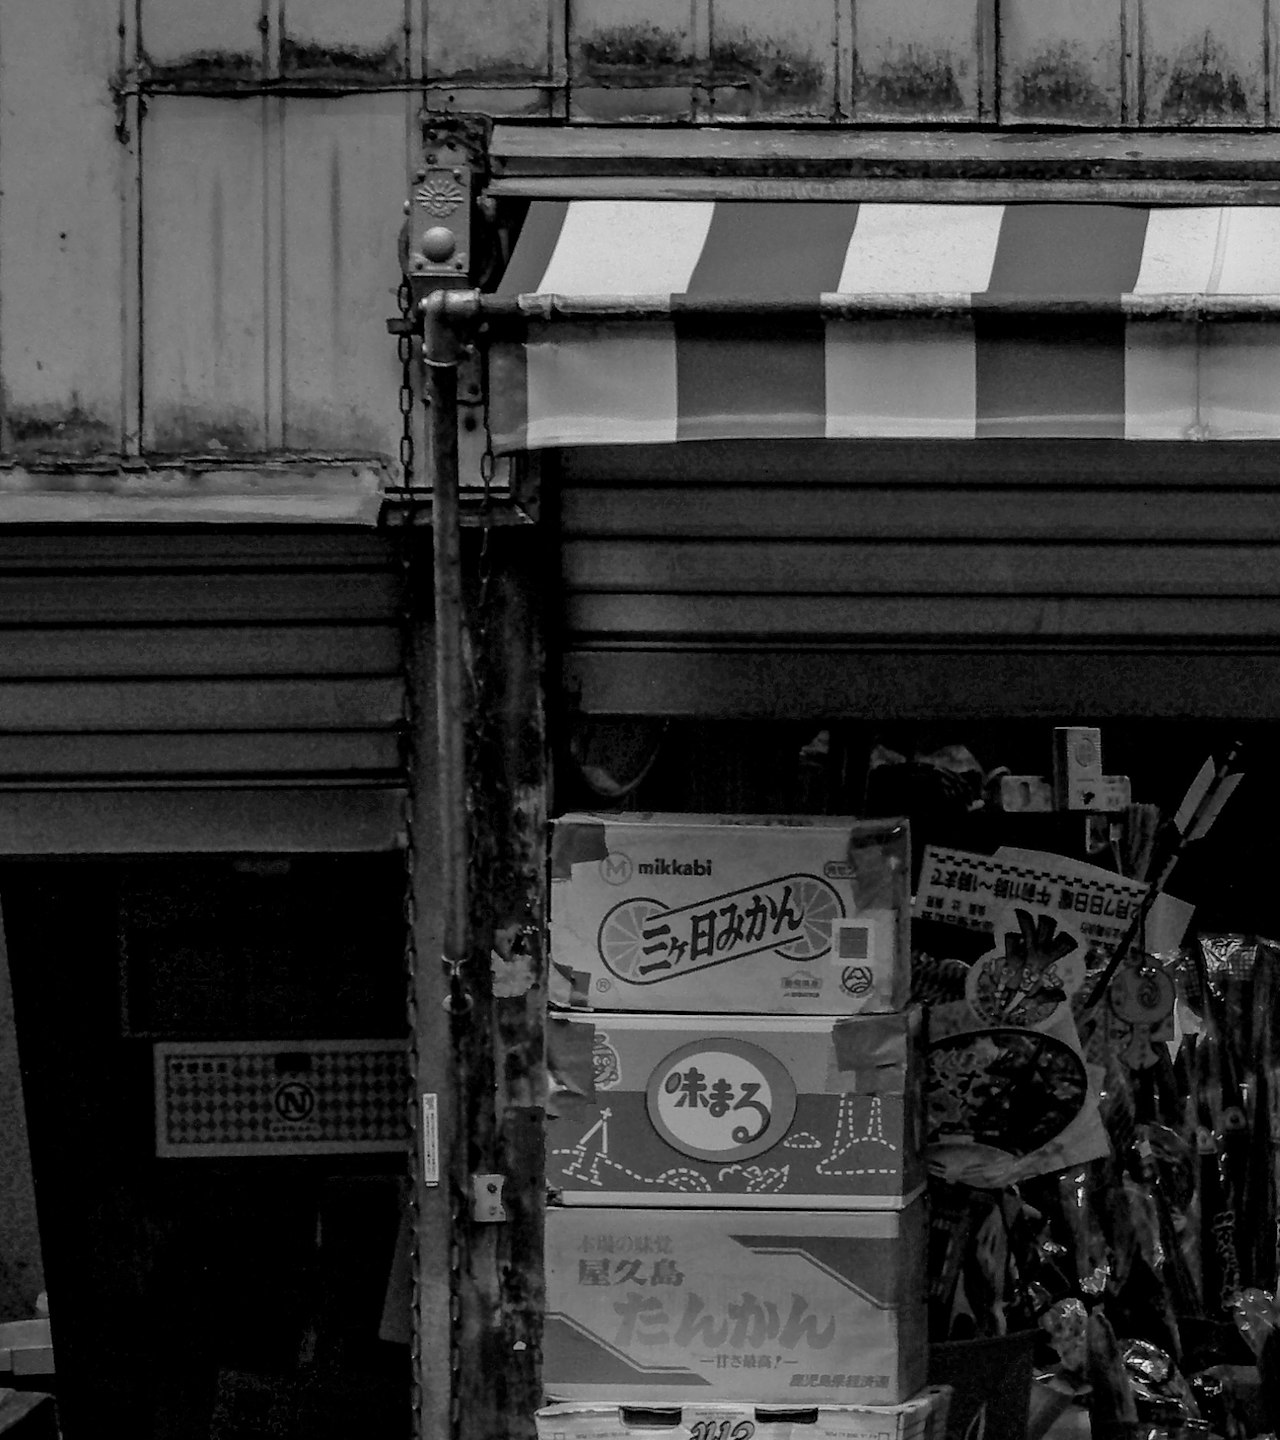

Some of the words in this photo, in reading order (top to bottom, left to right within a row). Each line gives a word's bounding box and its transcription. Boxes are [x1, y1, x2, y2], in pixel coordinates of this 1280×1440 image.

[638, 857, 713, 877] mikkabi
[664, 1066, 771, 1144] 味まろ
[577, 1258, 685, 1287] 屋久島
[612, 1291, 836, 1350] たんかん
